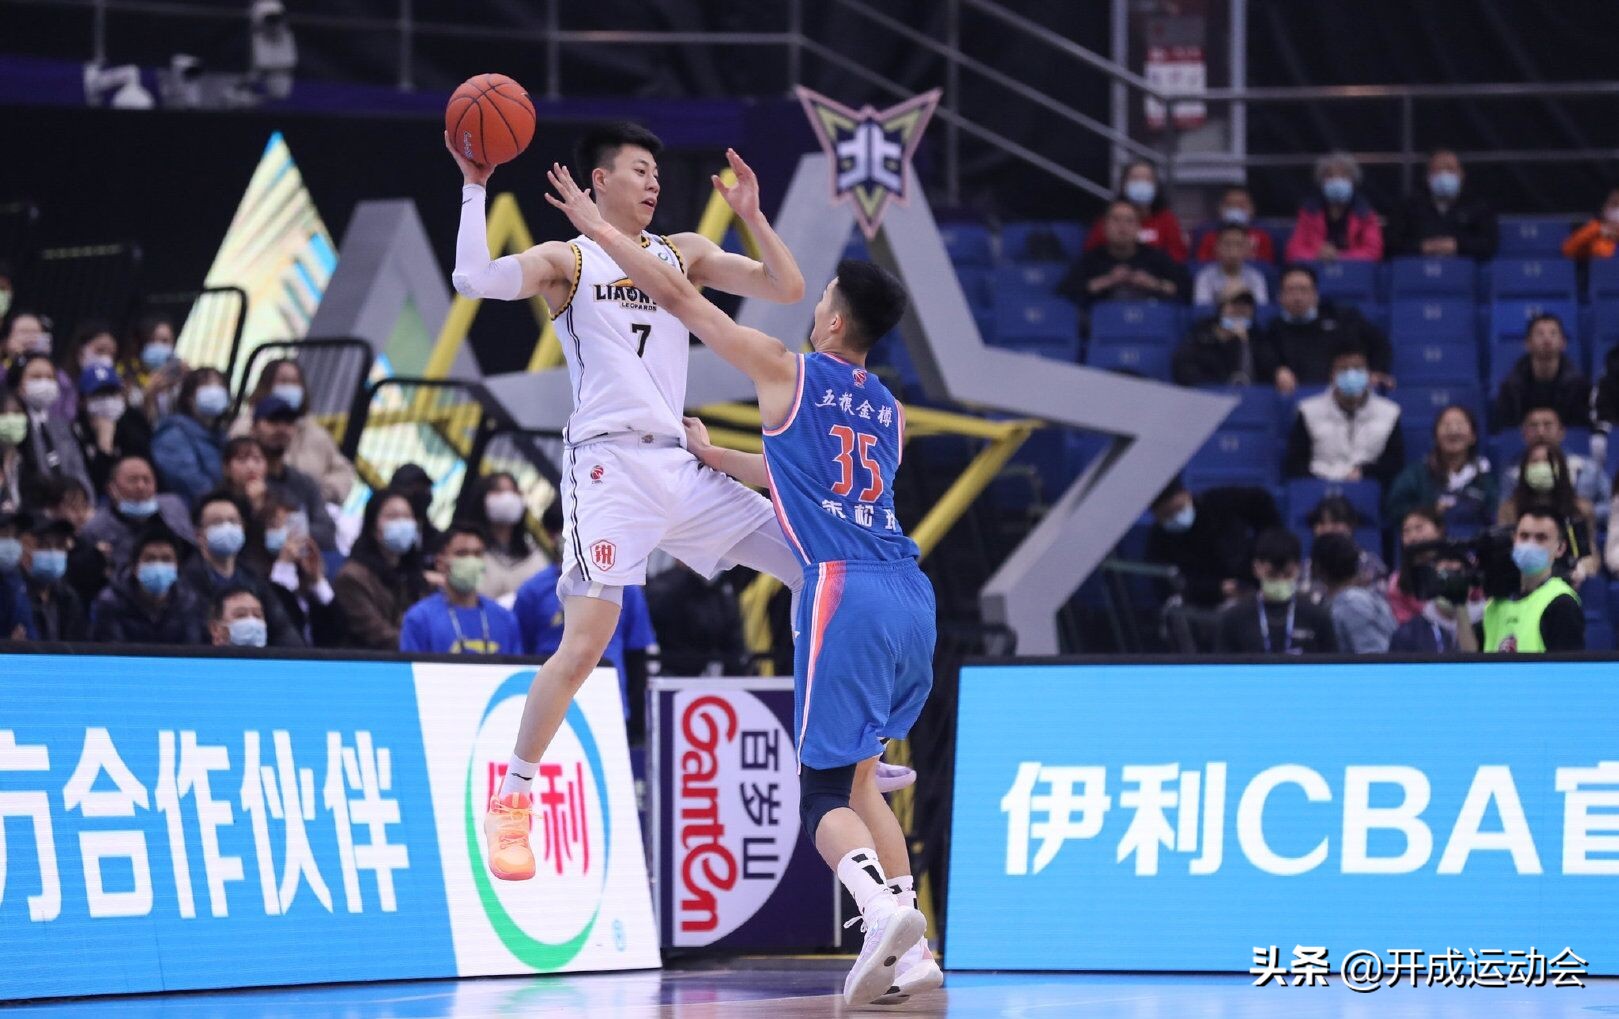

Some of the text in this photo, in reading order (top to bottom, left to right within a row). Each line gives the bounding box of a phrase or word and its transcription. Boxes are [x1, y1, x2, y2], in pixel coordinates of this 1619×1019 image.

[621, 301, 658, 313] LEOPARDS
[630, 322, 652, 359] 7
[829, 423, 884, 504] 35
[739, 728, 782, 880] 百岁山
